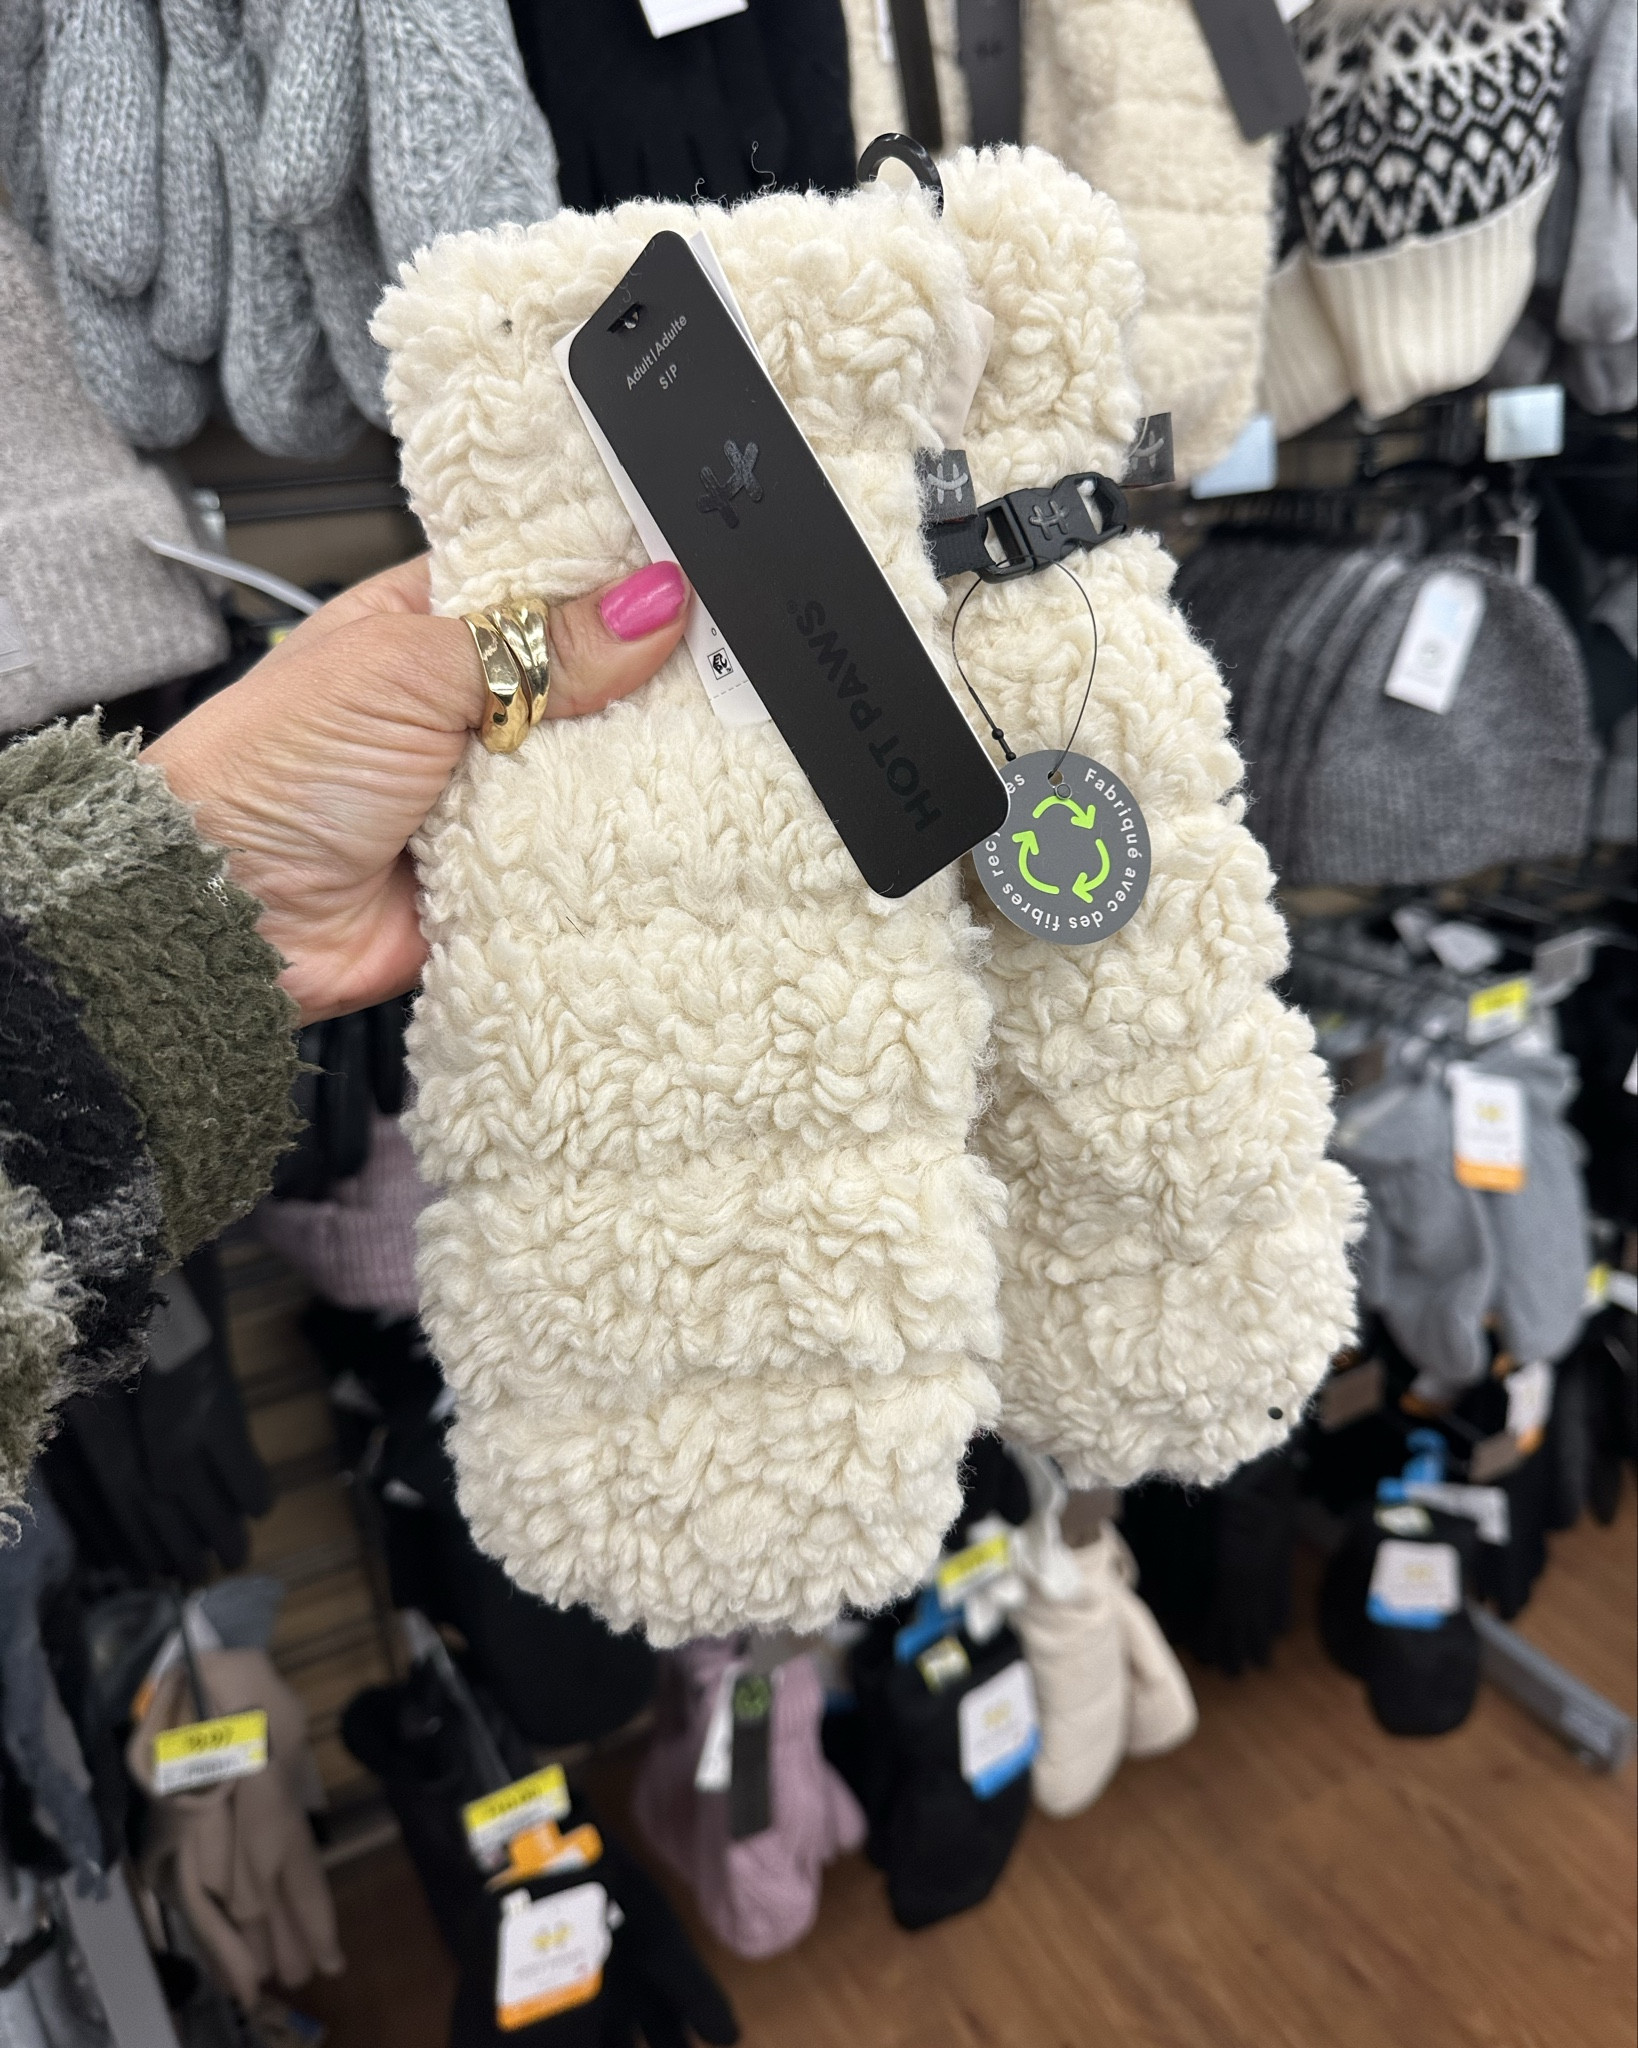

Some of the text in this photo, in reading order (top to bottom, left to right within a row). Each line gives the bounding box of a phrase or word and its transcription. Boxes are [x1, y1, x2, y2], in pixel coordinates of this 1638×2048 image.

[869, 735, 942, 833] HOT
[1085, 768, 1142, 859] Fabriqué
[1002, 883, 1060, 931] fibres
[1107, 866, 1136, 912] avec
[1068, 910, 1104, 928] des
